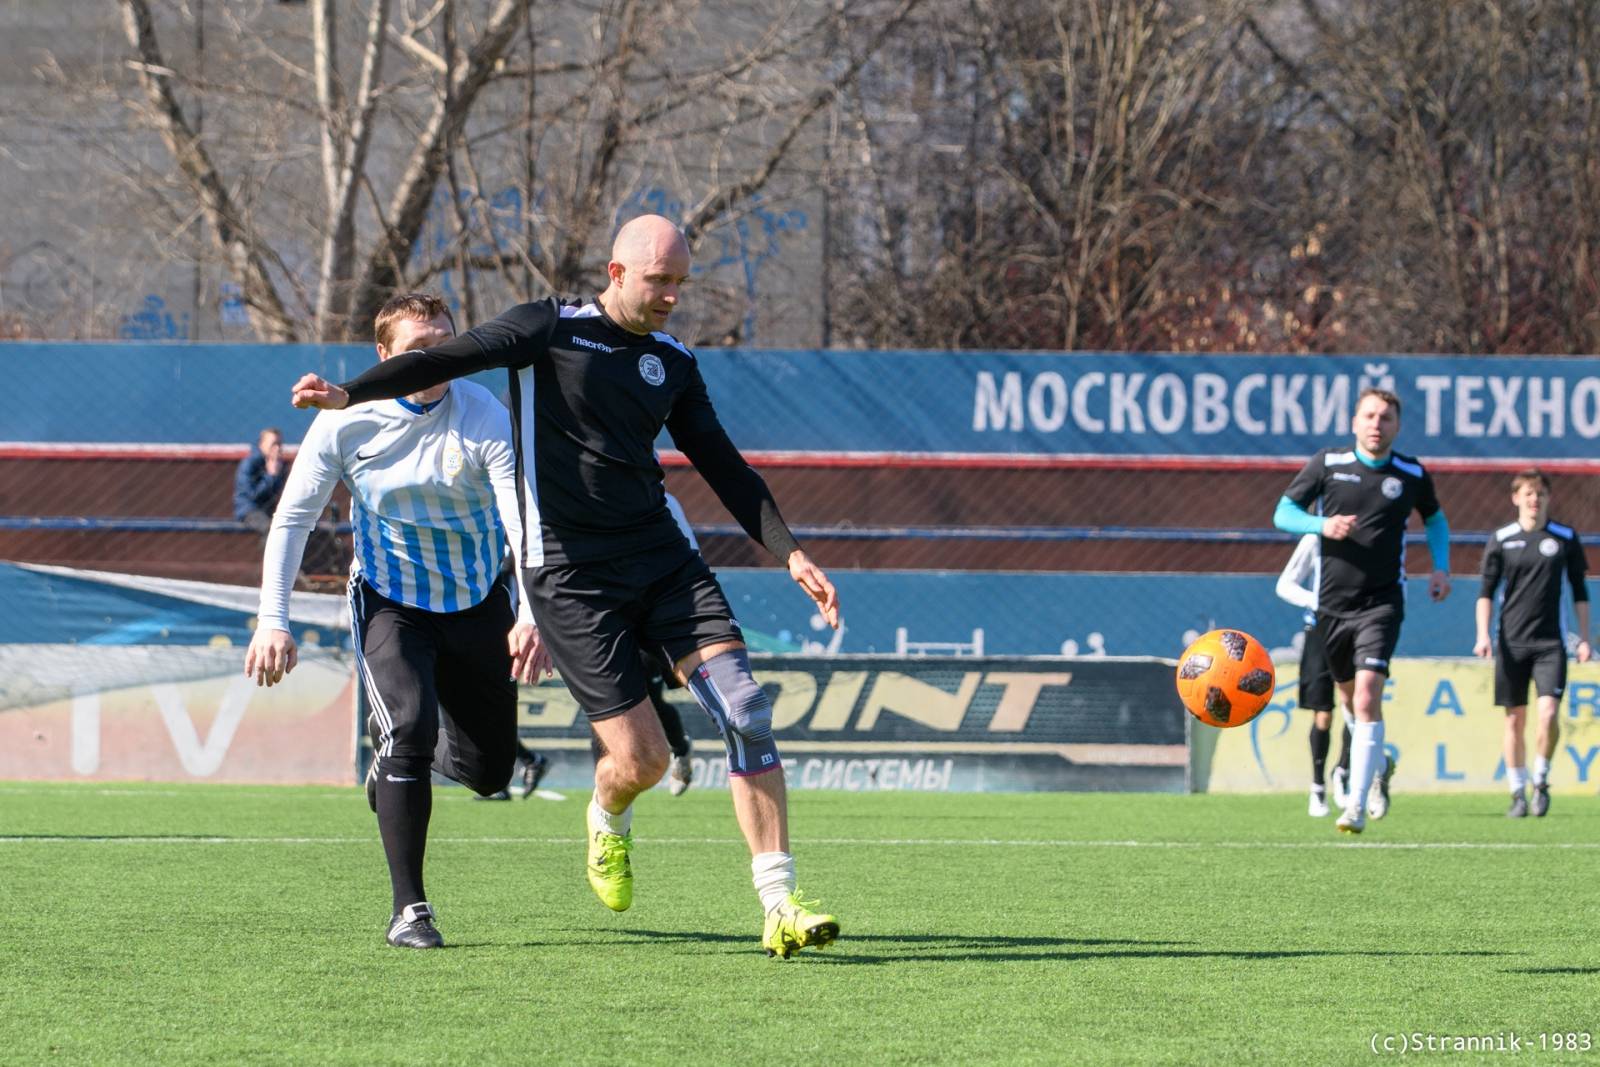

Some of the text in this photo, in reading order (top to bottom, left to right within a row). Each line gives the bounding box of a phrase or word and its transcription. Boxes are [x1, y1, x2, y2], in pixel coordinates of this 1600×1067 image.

[572, 335, 613, 353] macron
[1416, 375, 1600, 439] ТЕХНО
[663, 672, 1072, 732] OINT
[802, 759, 953, 790] СИСТЕМЫ
